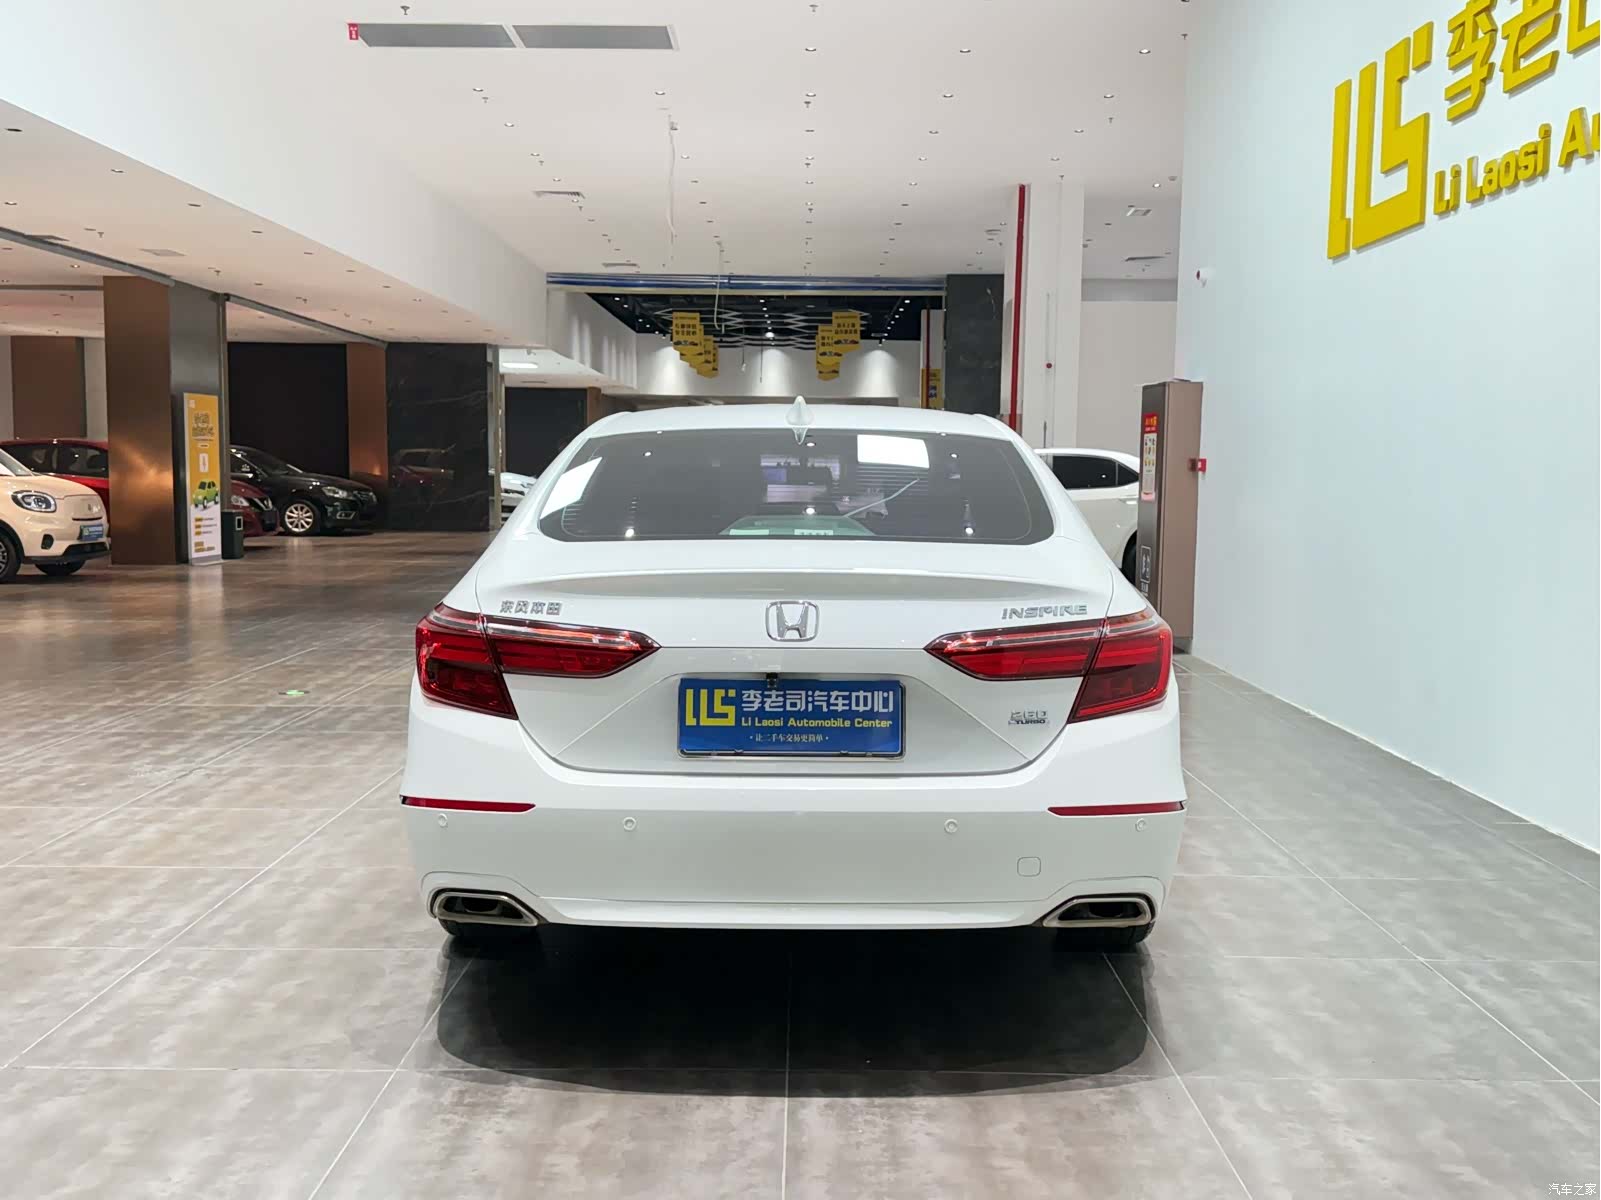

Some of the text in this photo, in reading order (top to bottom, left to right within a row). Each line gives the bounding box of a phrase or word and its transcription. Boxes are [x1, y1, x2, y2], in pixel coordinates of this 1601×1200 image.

[1433, 164, 1461, 215] Li
[1466, 123, 1552, 204] Laosi
[1001, 605, 1088, 620] INSPIRE
[741, 689, 894, 712] 李老司汽车中心
[741, 718, 893, 728] Li Laosi Automobile Center
